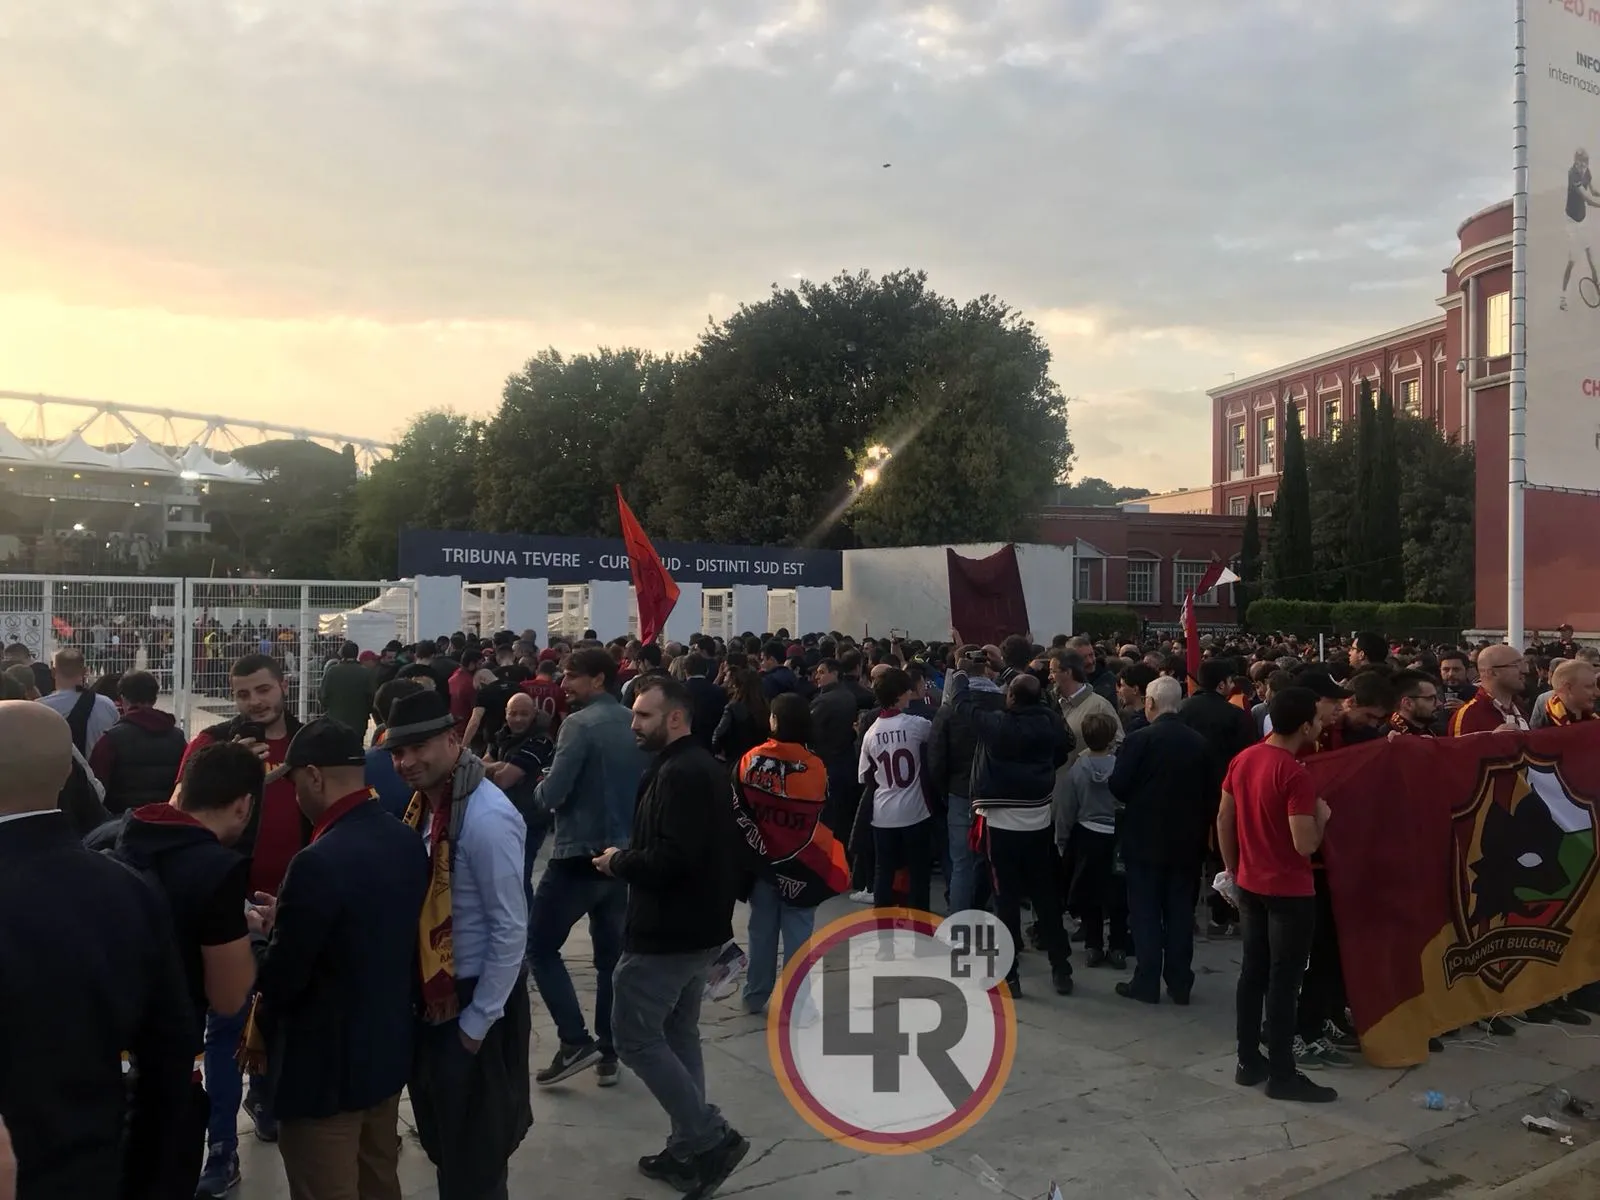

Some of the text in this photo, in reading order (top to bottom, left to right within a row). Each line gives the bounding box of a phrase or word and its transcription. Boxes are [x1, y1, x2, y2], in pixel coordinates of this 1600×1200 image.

[441, 547, 517, 566] TRIBUNA
[522, 551, 581, 567] TEVERE
[660, 557, 682, 571] UD
[696, 558, 749, 574] DISTINTI
[753, 561, 780, 575] SUD
[783, 562, 805, 576] EST
[875, 729, 908, 746] TOTTI
[876, 747, 917, 790] 10
